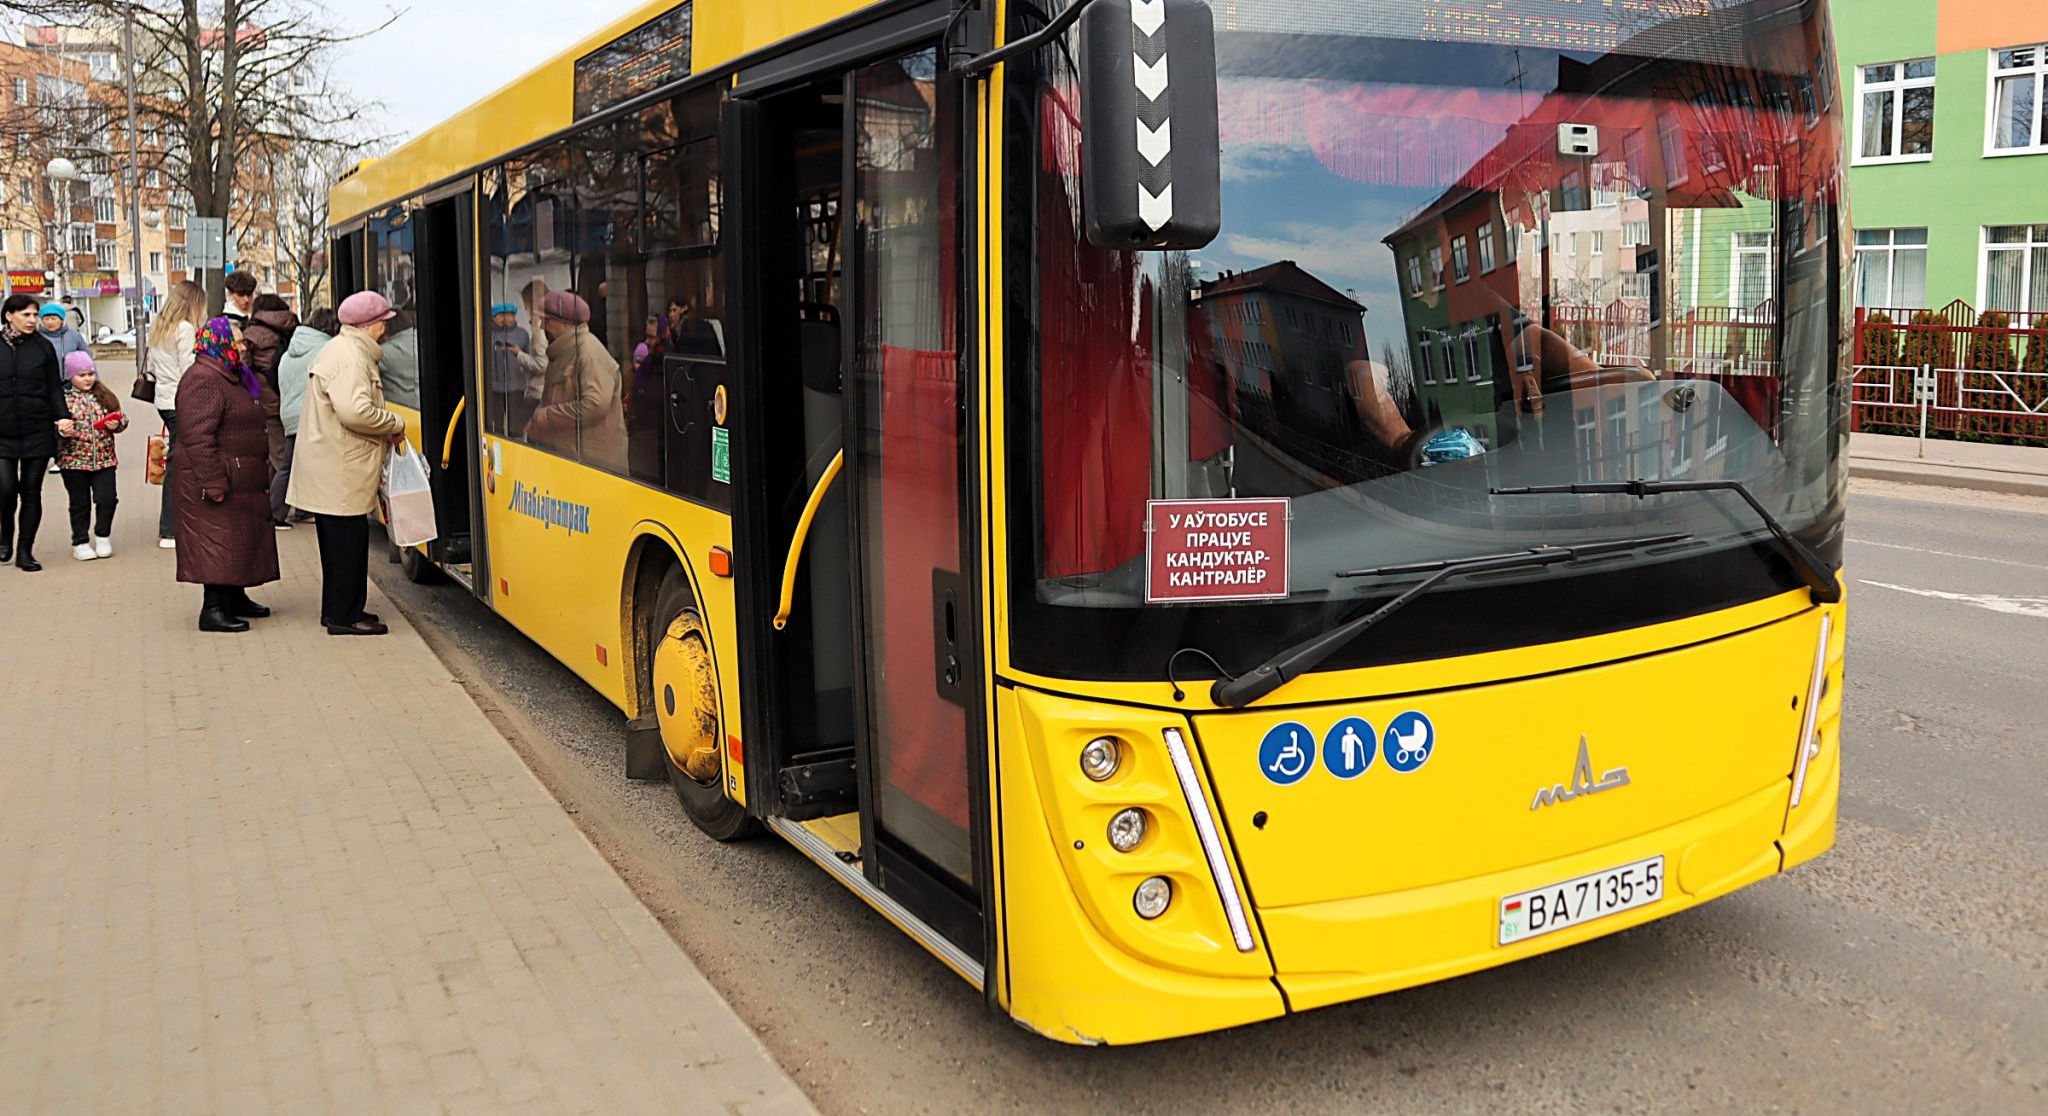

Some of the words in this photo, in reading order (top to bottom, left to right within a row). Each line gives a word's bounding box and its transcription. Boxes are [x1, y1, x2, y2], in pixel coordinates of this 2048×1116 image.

[1169, 513, 1181, 529] У
[1184, 511, 1268, 528] АЎТОБУСЕ
[1186, 532, 1252, 549] ПРАЦУЕ
[1166, 550, 1271, 568] КАНДУКТАР-
[1169, 567, 1267, 587] КАНТРАЛЁР
[1504, 921, 1521, 937] BY
